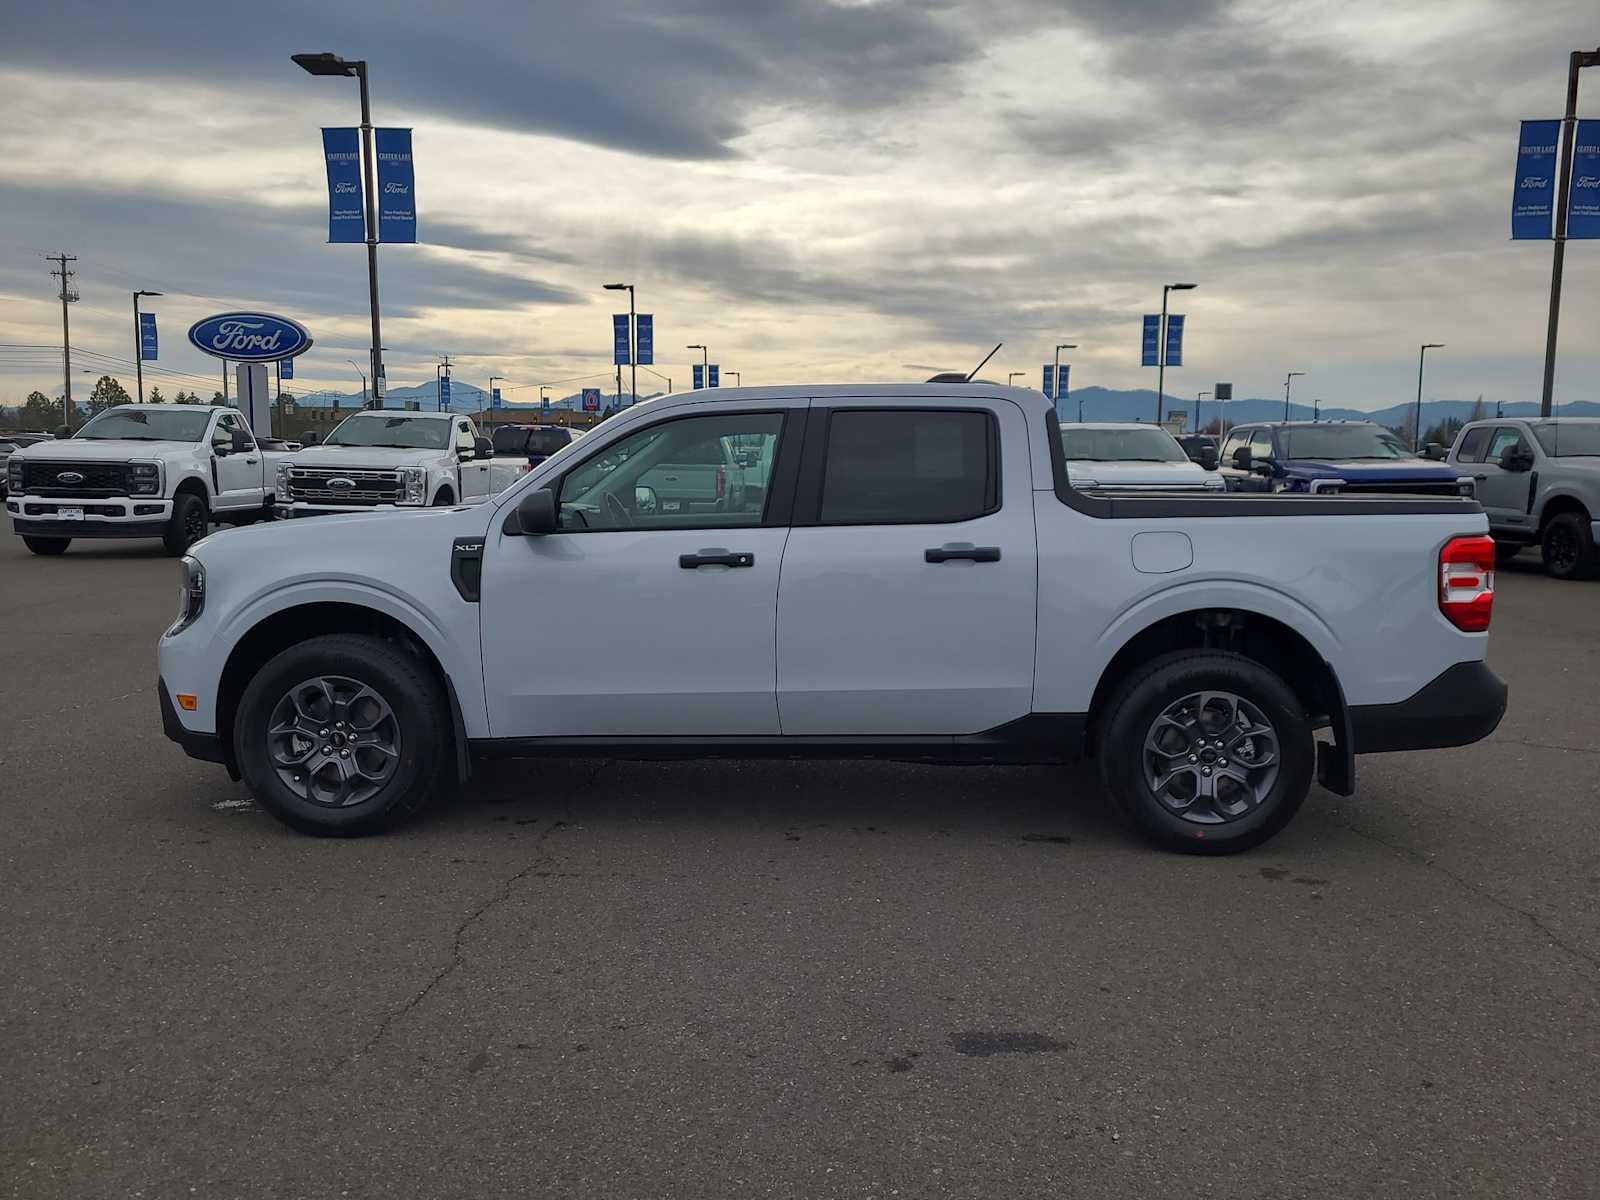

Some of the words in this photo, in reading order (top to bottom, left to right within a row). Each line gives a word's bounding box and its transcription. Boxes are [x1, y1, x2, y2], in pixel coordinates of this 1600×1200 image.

[335, 182, 357, 193] Ford
[384, 182, 409, 194] Ford
[1521, 176, 1548, 188] Ford
[212, 320, 282, 350] Ford
